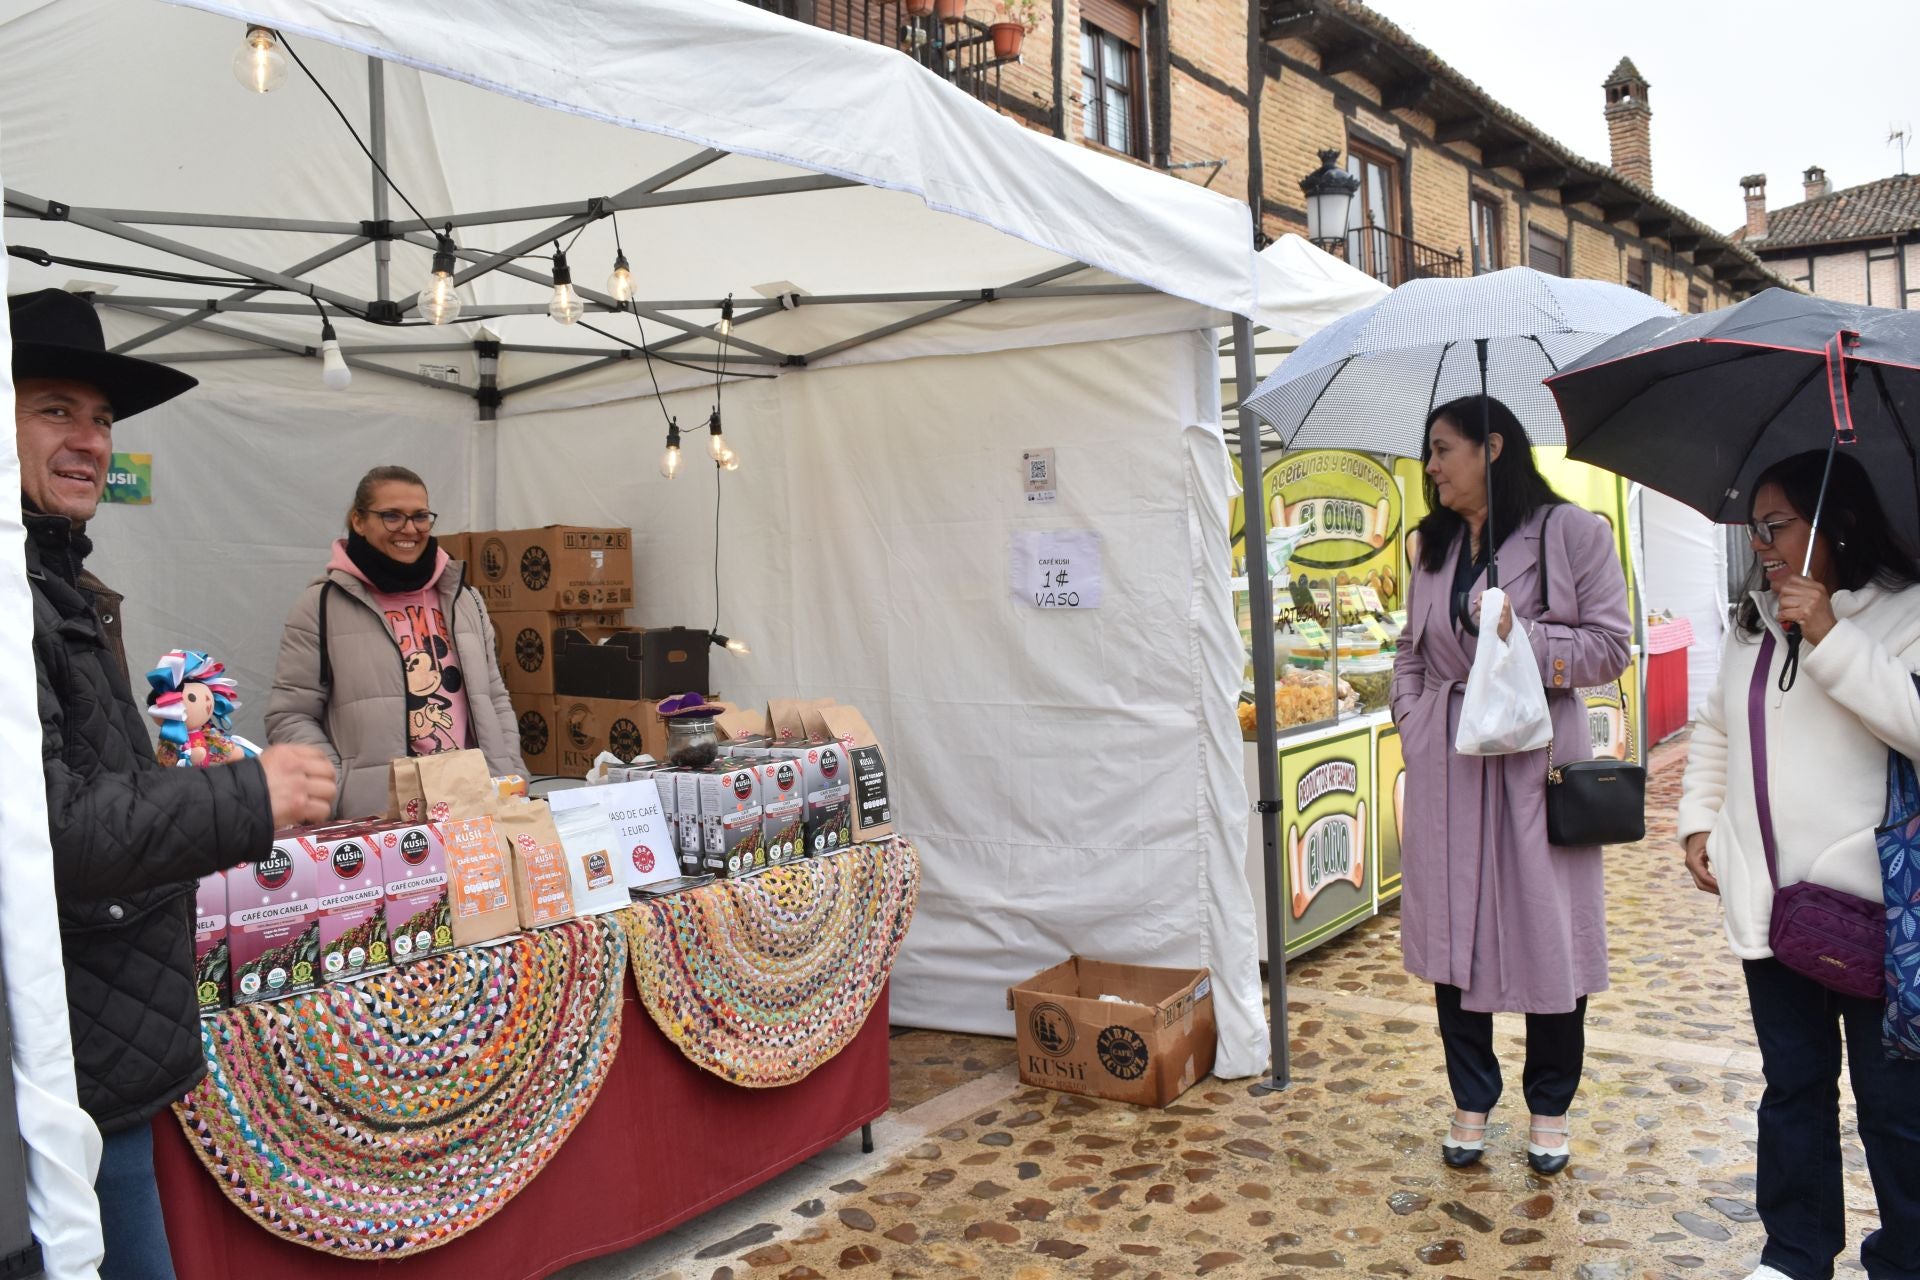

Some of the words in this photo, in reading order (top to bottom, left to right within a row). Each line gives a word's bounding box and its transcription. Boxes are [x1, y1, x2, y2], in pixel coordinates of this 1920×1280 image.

[1035, 591, 1080, 607] VASO
[608, 811, 626, 821] ASO
[626, 809, 638, 819] DE
[638, 804, 659, 817] CAFÉ
[627, 824, 650, 836] EURO
[391, 882, 407, 891] CAFÉ
[407, 880, 420, 888] CON
[420, 875, 444, 886] CANELA
[322, 897, 339, 907] CAFÉ
[340, 894, 354, 903] CON
[355, 889, 380, 901] CANELA
[241, 912, 261, 922] CAFÉ
[262, 908, 279, 918] CON
[279, 903, 309, 915] CANELA
[1100, 1028, 1143, 1051] LIBRE
